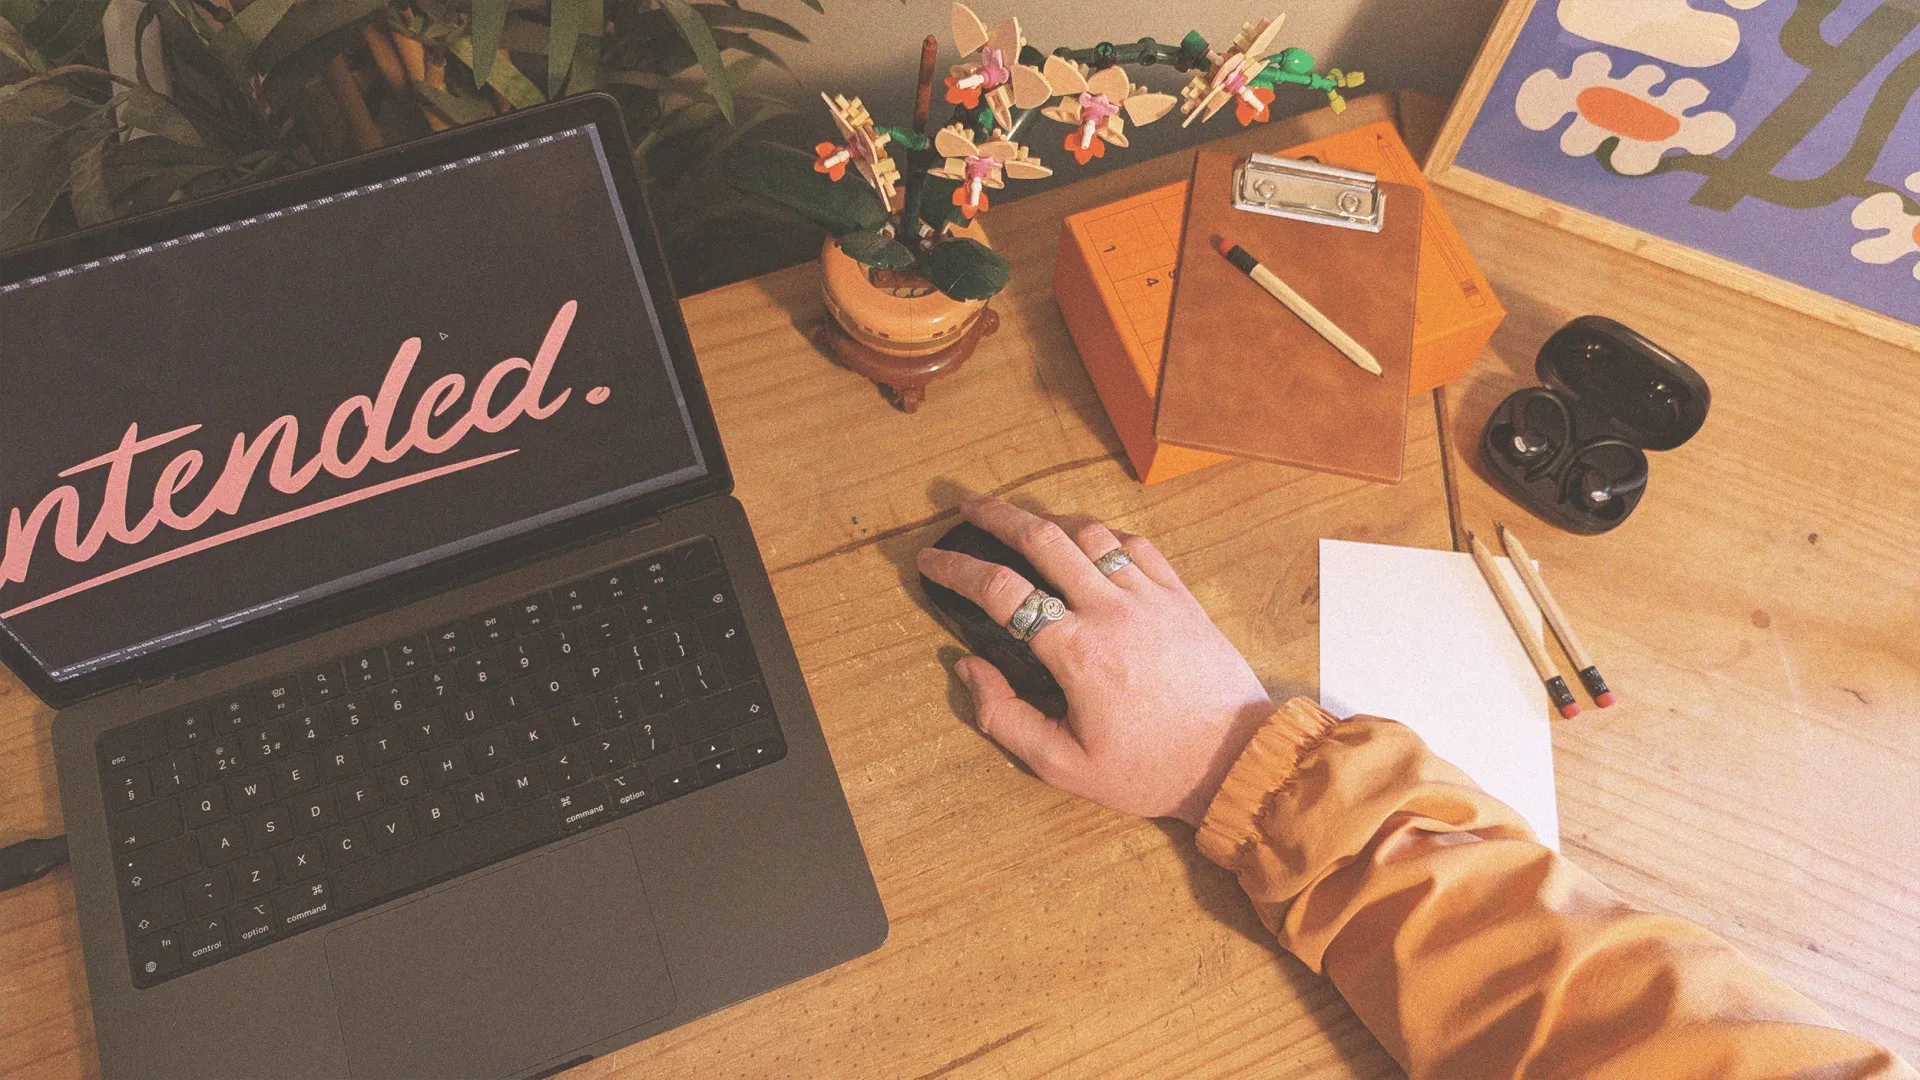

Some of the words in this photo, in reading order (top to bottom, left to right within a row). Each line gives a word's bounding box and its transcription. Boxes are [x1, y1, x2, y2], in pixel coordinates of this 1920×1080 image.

[30, 275, 47, 285] 2020
[57, 268, 74, 277] 2010
[84, 260, 100, 270] 2000
[110, 253, 126, 262] 1990
[137, 246, 152, 255] 1980
[163, 238, 179, 248] 1970
[189, 231, 205, 241] 1960
[215, 225, 231, 234] 1950
[241, 217, 257, 227] 1940
[267, 210, 282, 220] 1930
[293, 204, 308, 213] 1920
[318, 197, 333, 205] 1910
[343, 190, 358, 199] 1900
[368, 183, 383, 192] 1890
[393, 176, 407, 185] 1880
[418, 169, 432, 178] 1870
[442, 162, 457, 172] 1860
[467, 155, 481, 165] 1850
[491, 148, 505, 158] 1840
[515, 142, 530, 151] 1830
[539, 135, 553, 144] 1820
[563, 129, 577, 138] 1810
[1103, 244, 1116, 253] 1
[1146, 277, 1160, 287] 4
[0, 300, 610, 590] ntended.
[563, 644, 571, 653] 0
[521, 658, 528, 667] 9
[479, 672, 487, 681] 8
[592, 668, 600, 677] P
[437, 686, 443, 695] 7
[550, 682, 559, 691] O
[394, 701, 402, 710] 6
[510, 697, 515, 705] I
[351, 715, 359, 725] 5
[465, 711, 474, 720] U
[572, 717, 580, 726] L
[308, 730, 315, 738] 4
[423, 725, 430, 734] Y
[530, 731, 538, 741] K
[263, 745, 271, 754] 3
[380, 740, 386, 749] T
[488, 746, 494, 756] J
[112, 756, 125, 765] esc
[219, 760, 226, 770] 2
[336, 755, 344, 765] R
[443, 760, 452, 771] H
[174, 775, 179, 784] 1
[292, 770, 300, 780] E
[400, 776, 409, 785] G
[517, 777, 528, 788] M
[245, 784, 256, 795] W
[357, 791, 363, 800] F
[475, 792, 484, 802] N
[620, 791, 644, 803] option
[202, 801, 210, 811] Q
[311, 806, 320, 817] D
[432, 808, 440, 818] B
[566, 804, 604, 823] command
[266, 822, 275, 832] S
[387, 823, 395, 833] V
[222, 838, 229, 848] A
[343, 839, 351, 849] C
[298, 855, 306, 865] X
[252, 871, 260, 882] Z
[287, 904, 326, 923] command
[243, 926, 268, 939] option
[193, 941, 221, 957] control
